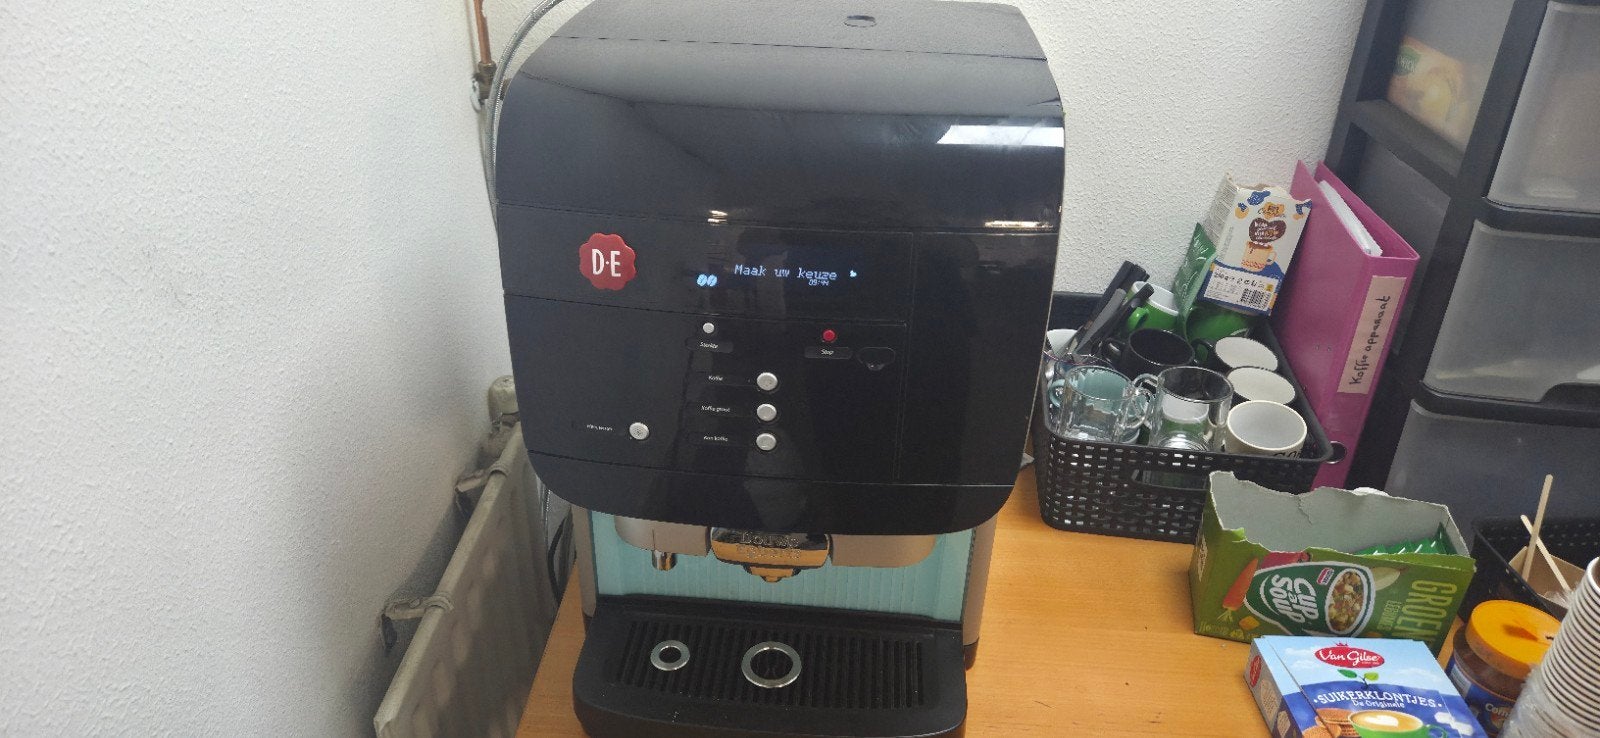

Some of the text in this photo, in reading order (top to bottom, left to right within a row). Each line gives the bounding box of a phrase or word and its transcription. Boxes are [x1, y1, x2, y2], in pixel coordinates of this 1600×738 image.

[734, 263, 838, 282] Maak uw keuze
[1348, 355, 1370, 386] Koffie
[1318, 650, 1379, 667] Van Gilse
[1316, 690, 1436, 708] SUIKERKLONTJES
[1353, 699, 1365, 707] De
